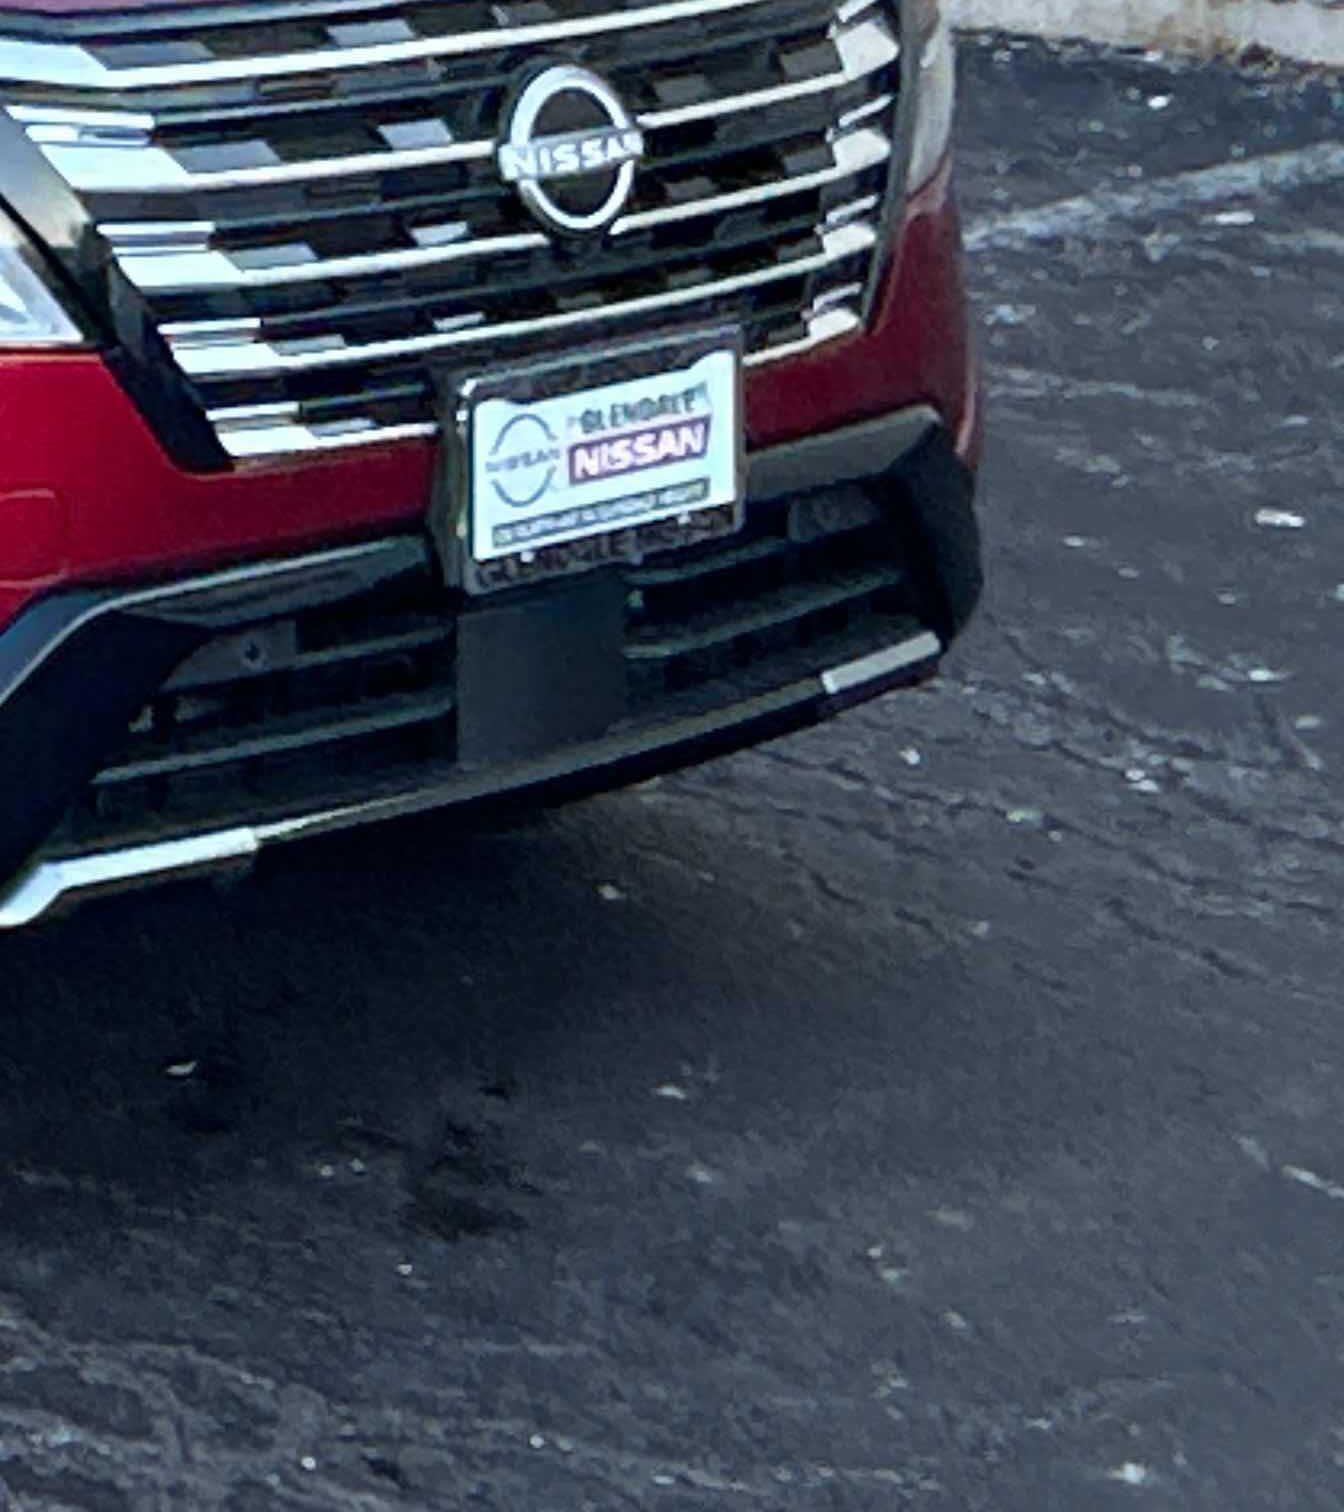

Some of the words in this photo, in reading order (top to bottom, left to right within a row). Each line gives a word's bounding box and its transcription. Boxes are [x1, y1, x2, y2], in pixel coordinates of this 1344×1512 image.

[499, 131, 644, 181] NISSAN
[580, 392, 697, 434] GLENDALE
[485, 447, 560, 473] NISSAN
[573, 421, 706, 478] NISSAN
